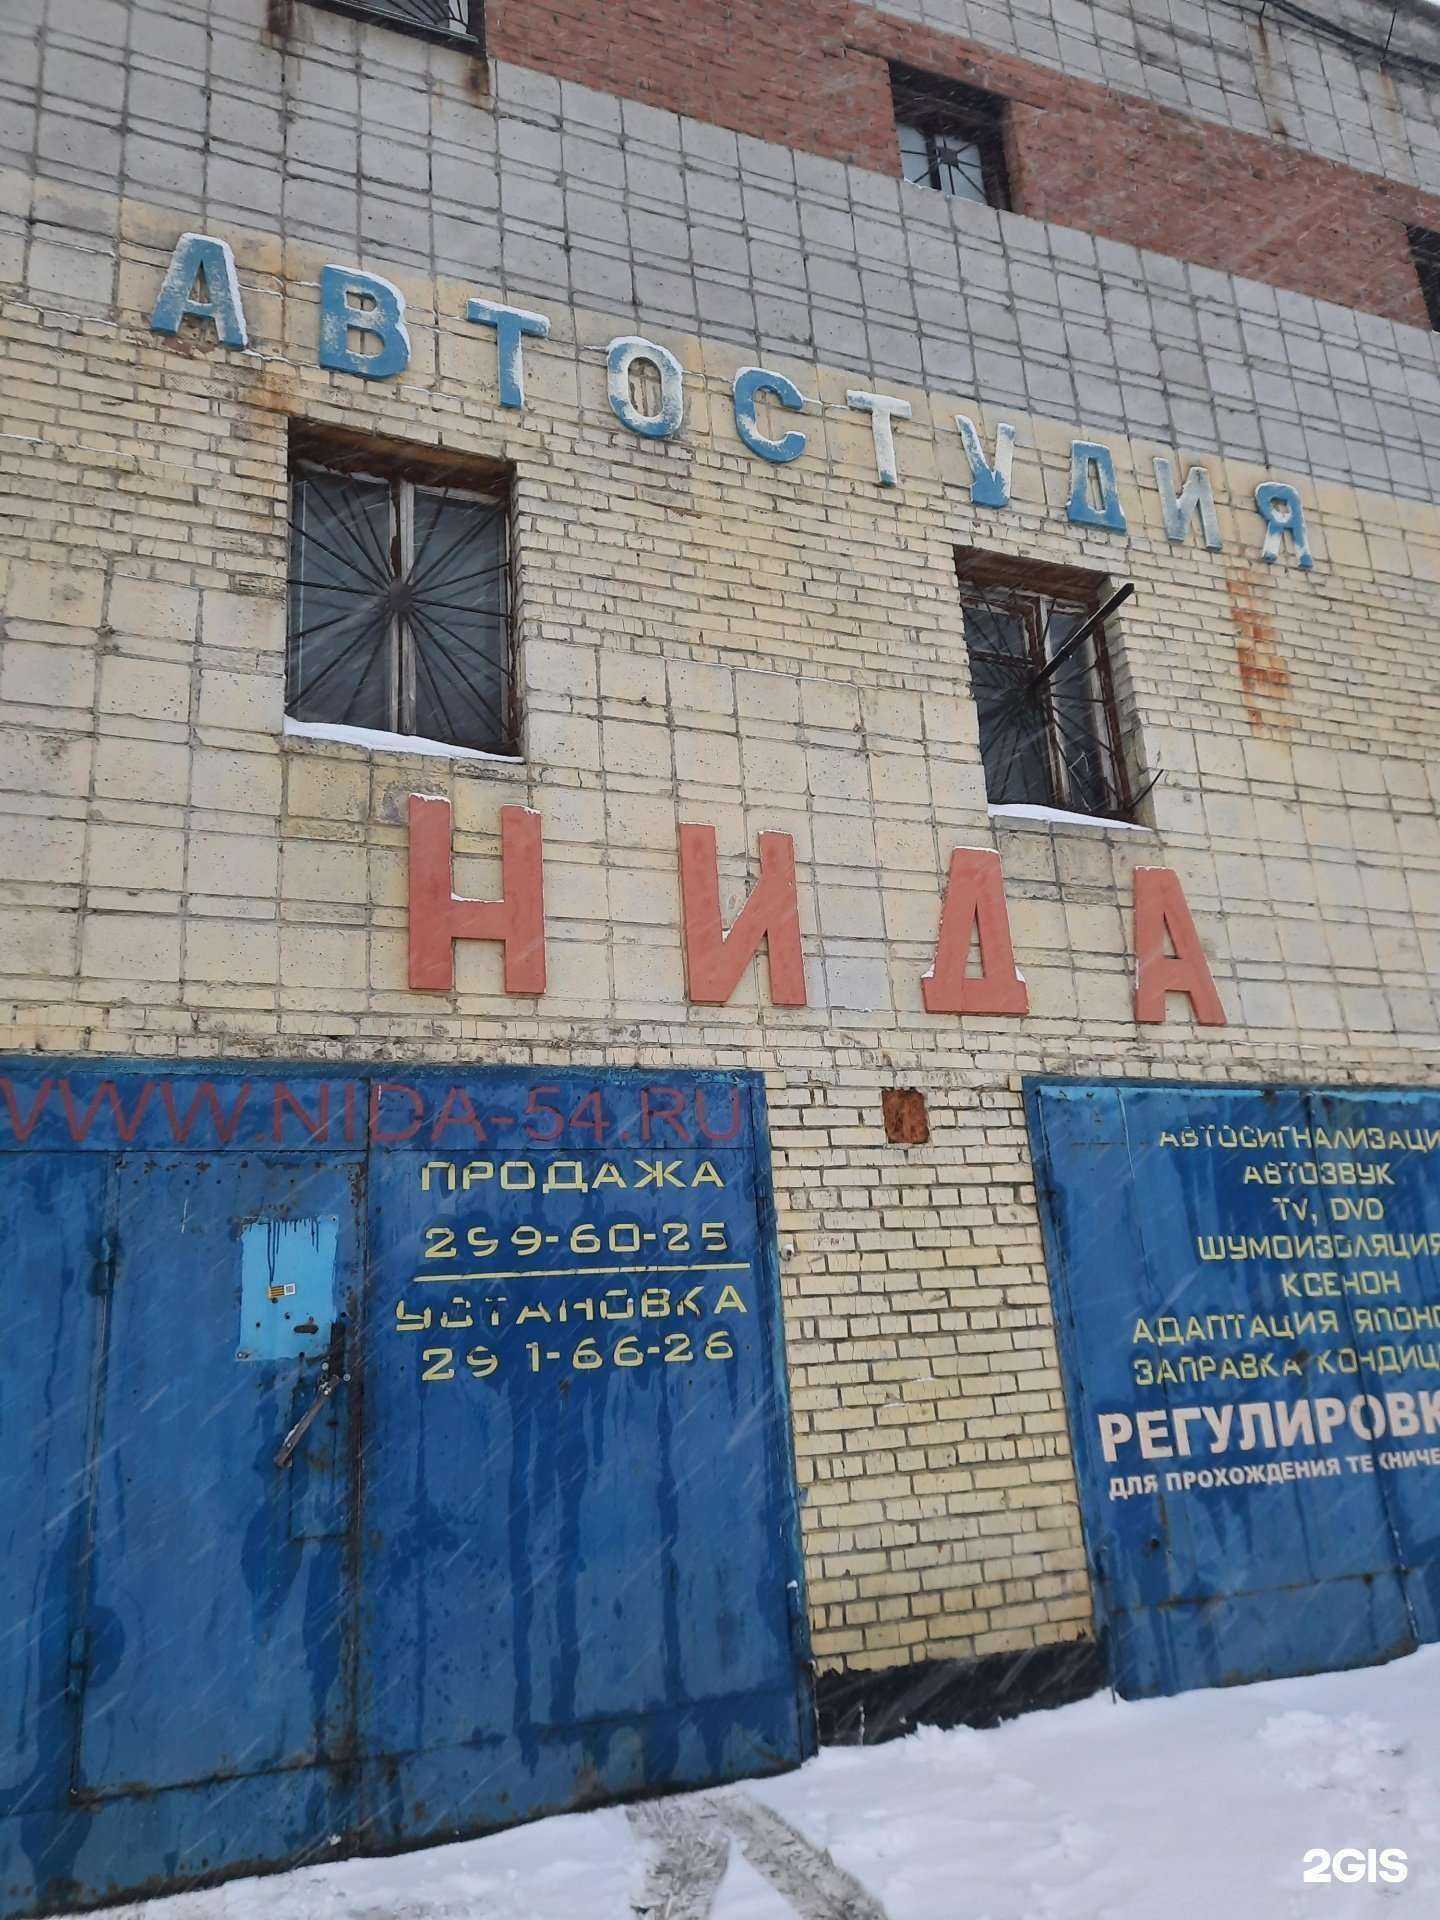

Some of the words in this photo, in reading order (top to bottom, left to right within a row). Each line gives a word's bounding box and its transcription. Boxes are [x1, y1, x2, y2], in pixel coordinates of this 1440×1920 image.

[150, 231, 1313, 571] АВТОСТУДИЯ
[408, 792, 1226, 1027] НИДА
[421, 1160, 726, 1194] ПРОДАЖА
[1243, 1161, 1396, 1186] АВТОЗВУК
[1272, 1197, 1319, 1226] TV,
[1330, 1197, 1385, 1221] DVD
[424, 1222, 729, 1258] 299-60-25
[1281, 1270, 1402, 1298] КСЕНОН
[395, 1284, 748, 1331] УСТАНОВКА
[1132, 1309, 1339, 1346] АДАПТАЦИЯ
[1133, 1352, 1303, 1387] ЗАПРАВКА
[1108, 1474, 1159, 1501] ДЛЯ
[1165, 1457, 1342, 1492] ПРОХОЖДЕНИЯ
